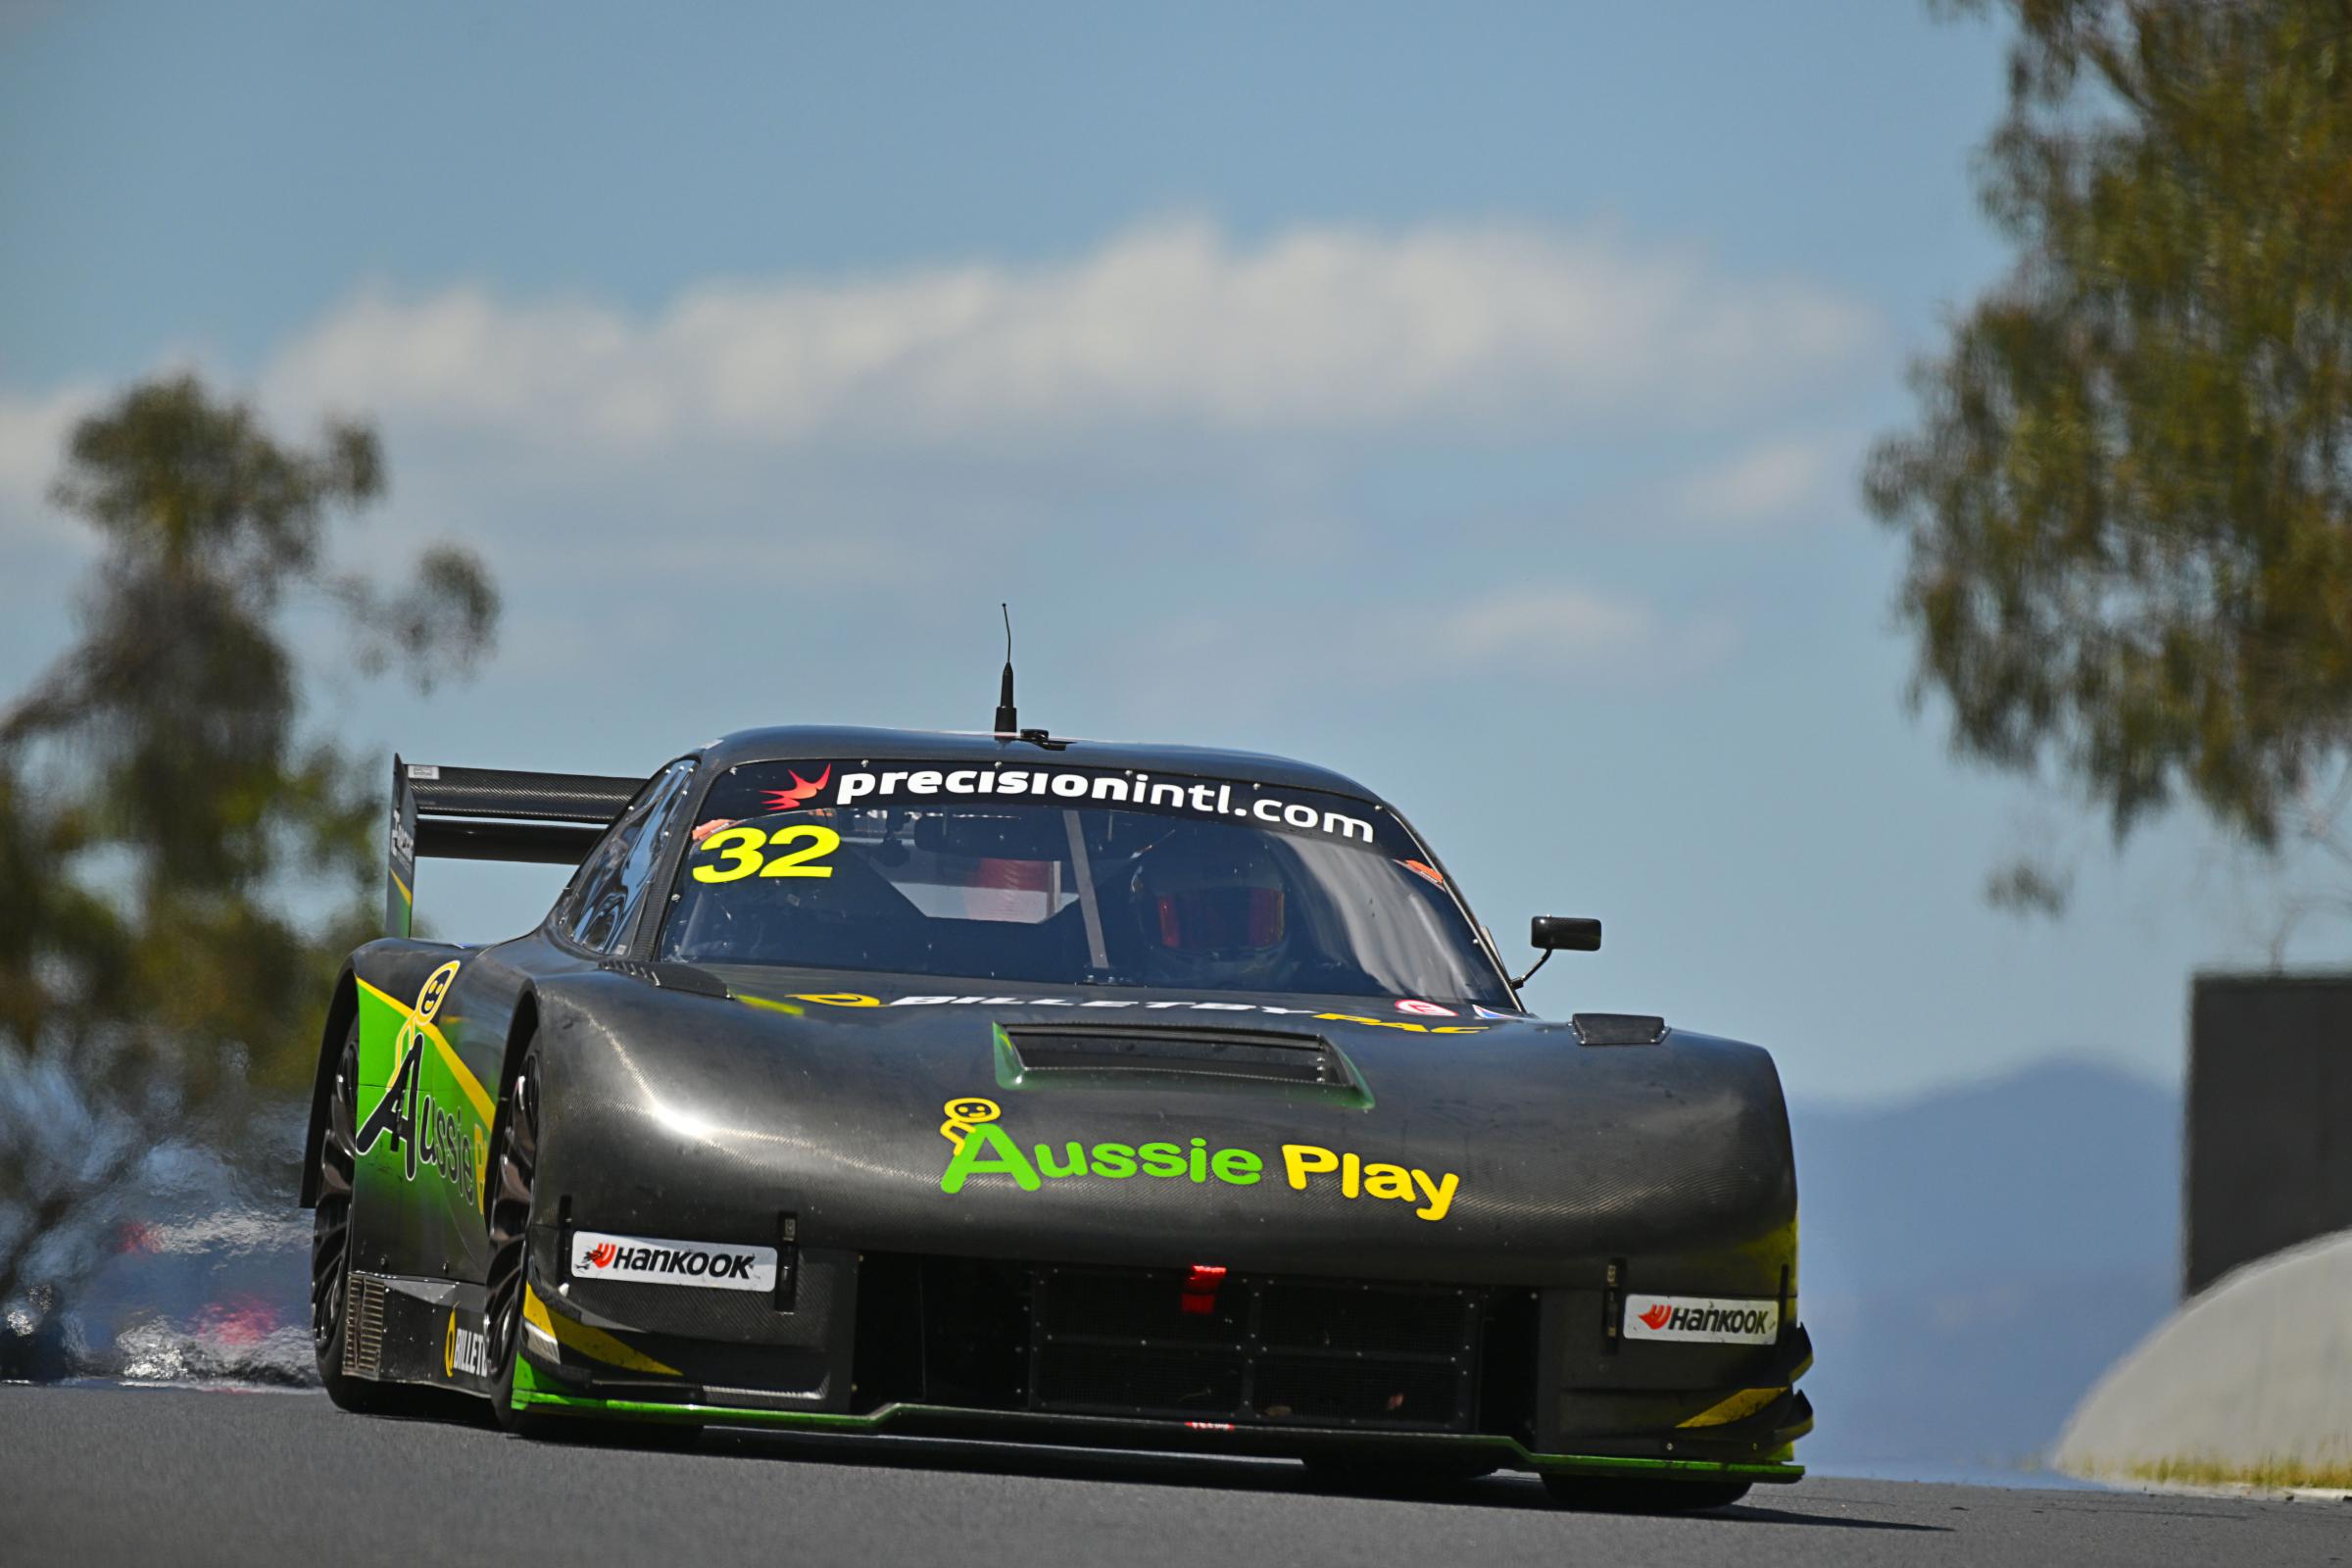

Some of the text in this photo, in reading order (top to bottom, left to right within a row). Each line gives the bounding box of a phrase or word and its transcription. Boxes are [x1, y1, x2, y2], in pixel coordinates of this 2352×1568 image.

[835, 768, 1374, 844] precisionintl.com
[692, 824, 841, 883] 32
[355, 1032, 474, 1206] Aussie
[941, 1123, 1459, 1221] Aussie Play
